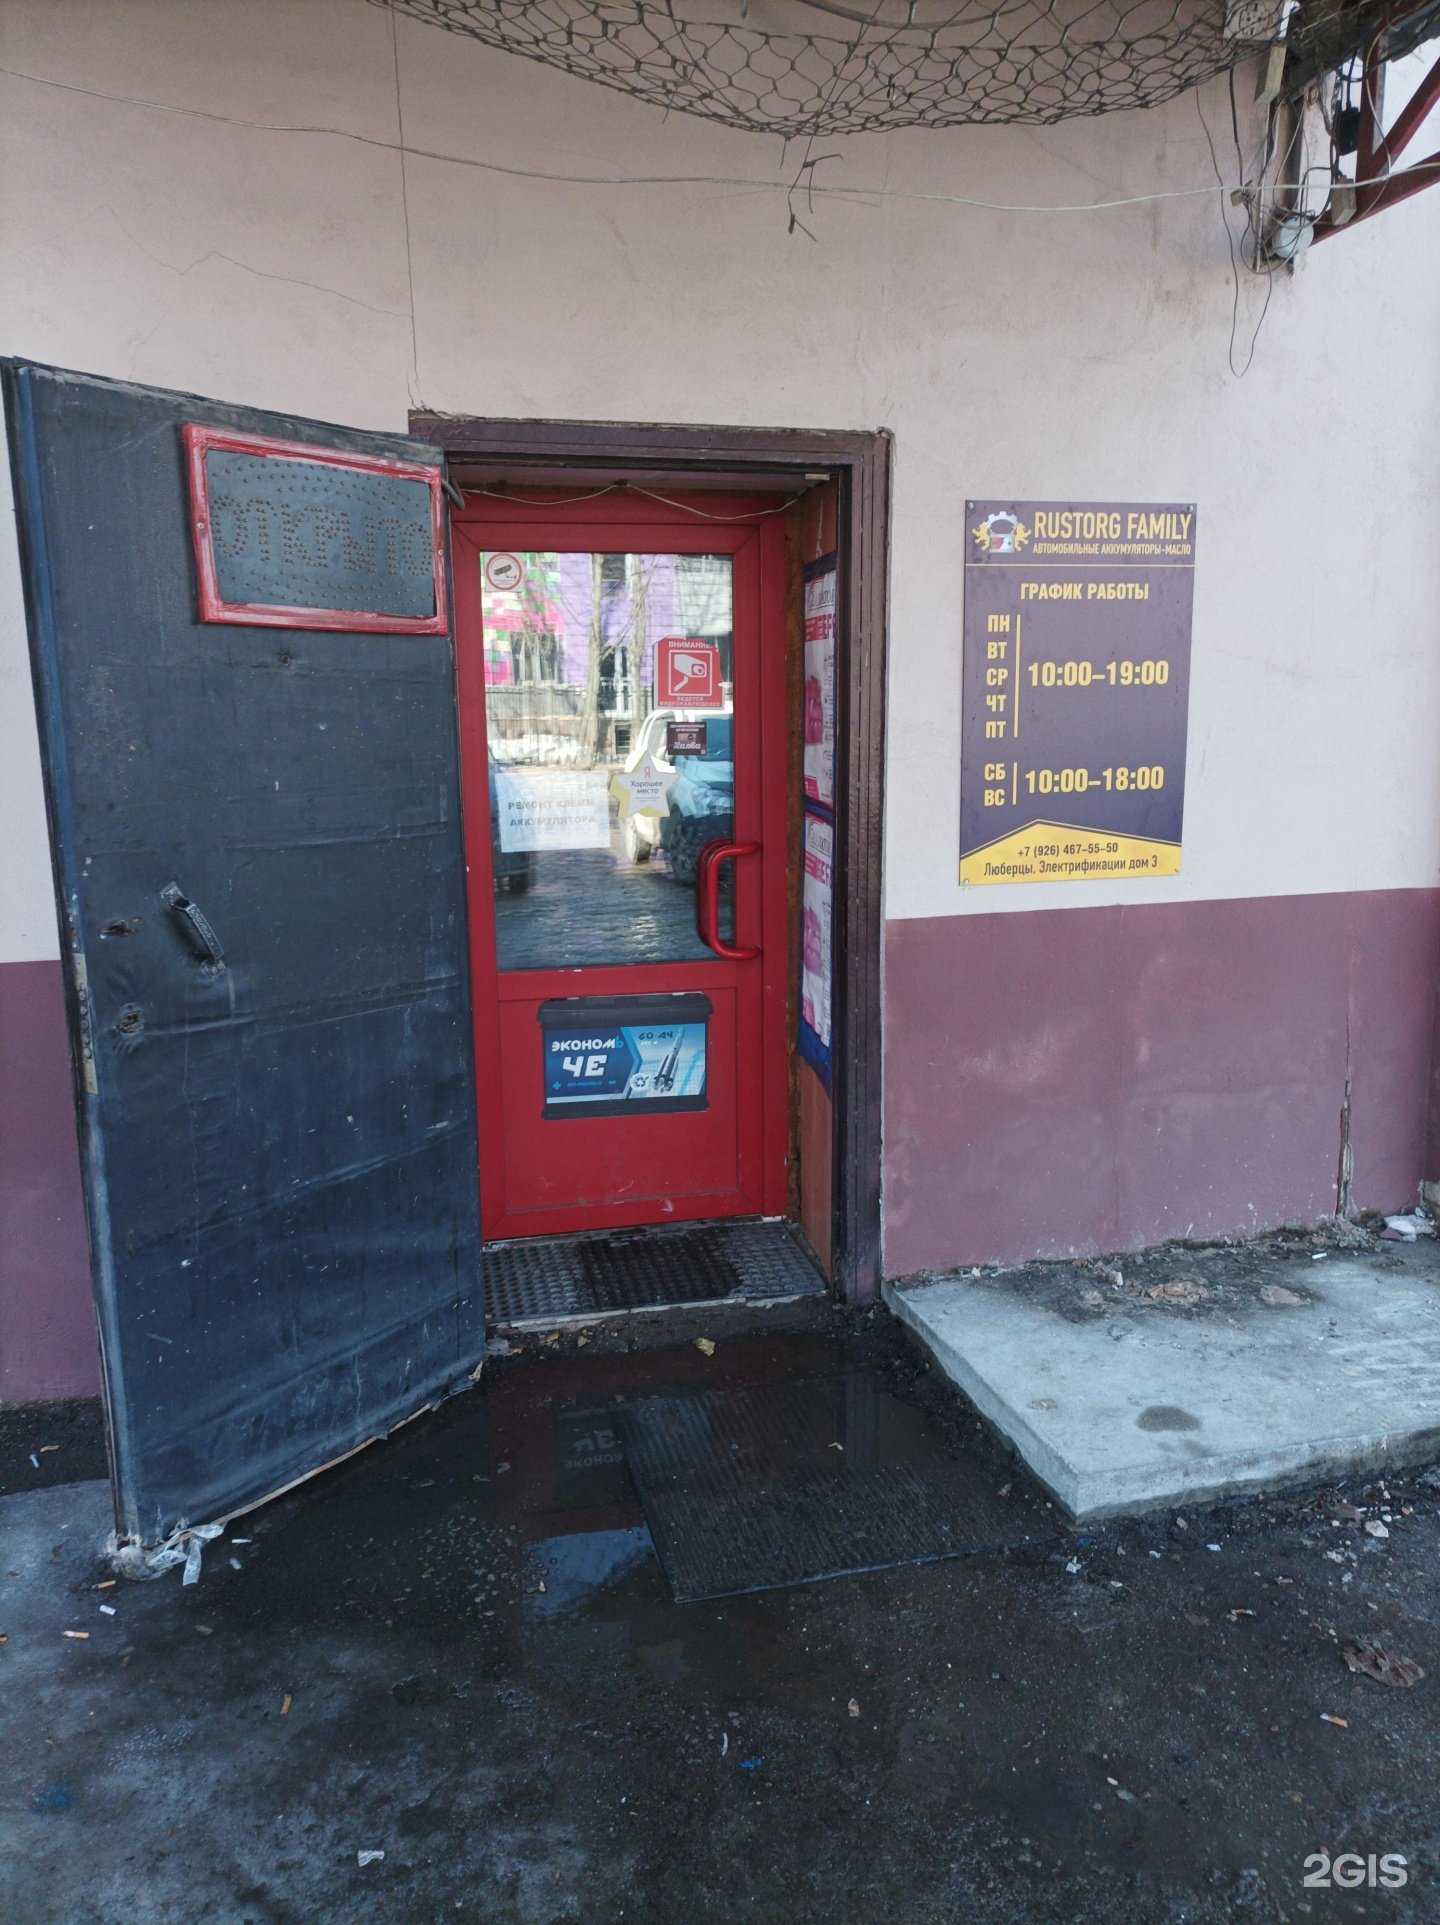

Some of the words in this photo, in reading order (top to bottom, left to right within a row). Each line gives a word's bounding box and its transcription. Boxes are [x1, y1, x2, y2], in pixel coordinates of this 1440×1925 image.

[1033, 511, 1121, 540] RUSTORG
[1127, 512, 1192, 540] FAMILY
[1032, 543, 1101, 554] АВТОМОБИЛЬНЫЕ
[1020, 583, 1083, 600] ГРАФИК
[1087, 583, 1149, 600] РАБОТЫ
[987, 614, 1010, 632] ПН
[987, 641, 1008, 659] ВТ
[986, 668, 1009, 686] СР
[1028, 660, 1169, 686] 10:00-19:00
[986, 695, 1007, 712] ЧТ
[985, 721, 1007, 738] ПТ
[984, 763, 1006, 781] СБ
[1025, 766, 1165, 793] 10:00-18:00
[983, 789, 1006, 806] ВС
[1018, 846, 1031, 857] +7
[1034, 845, 1060, 857] (926)
[1063, 842, 1118, 855] 467-55-50
[1039, 857, 1126, 876] Электрификации
[1128, 859, 1149, 872] дом
[1151, 855, 1158, 868] 3
